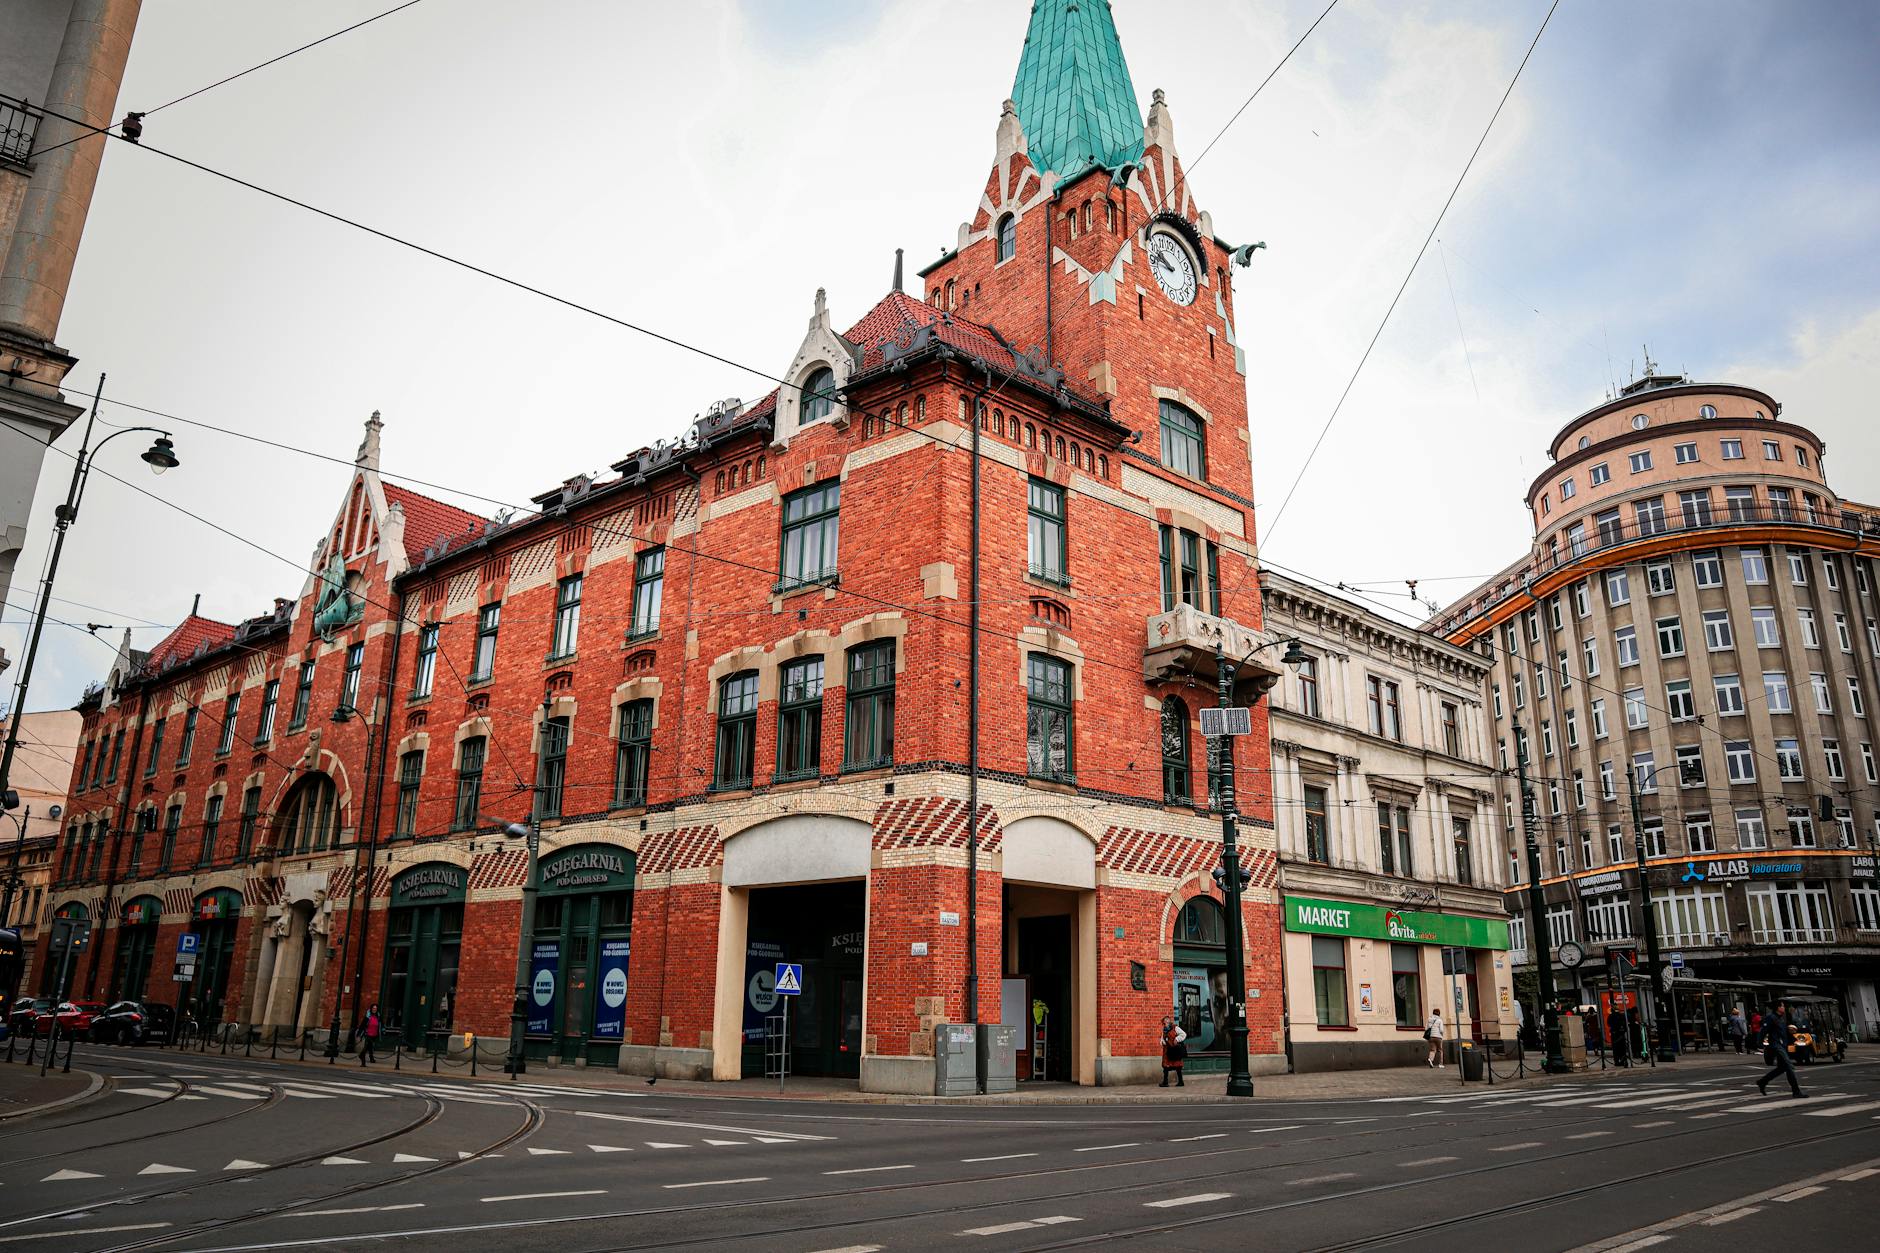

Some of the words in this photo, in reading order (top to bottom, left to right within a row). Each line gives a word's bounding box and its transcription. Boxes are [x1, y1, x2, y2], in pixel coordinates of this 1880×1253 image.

[542, 853, 624, 882] KSIĘGARNIA
[1707, 860, 1749, 876] ALAB
[1751, 863, 1803, 874] laboratoria
[399, 870, 459, 893] KSIĘGARNIA
[556, 877, 570, 887] POD
[1578, 871, 1621, 888] LABORATORIUM
[1298, 905, 1350, 929] MARKET
[182, 935, 196, 951] P
